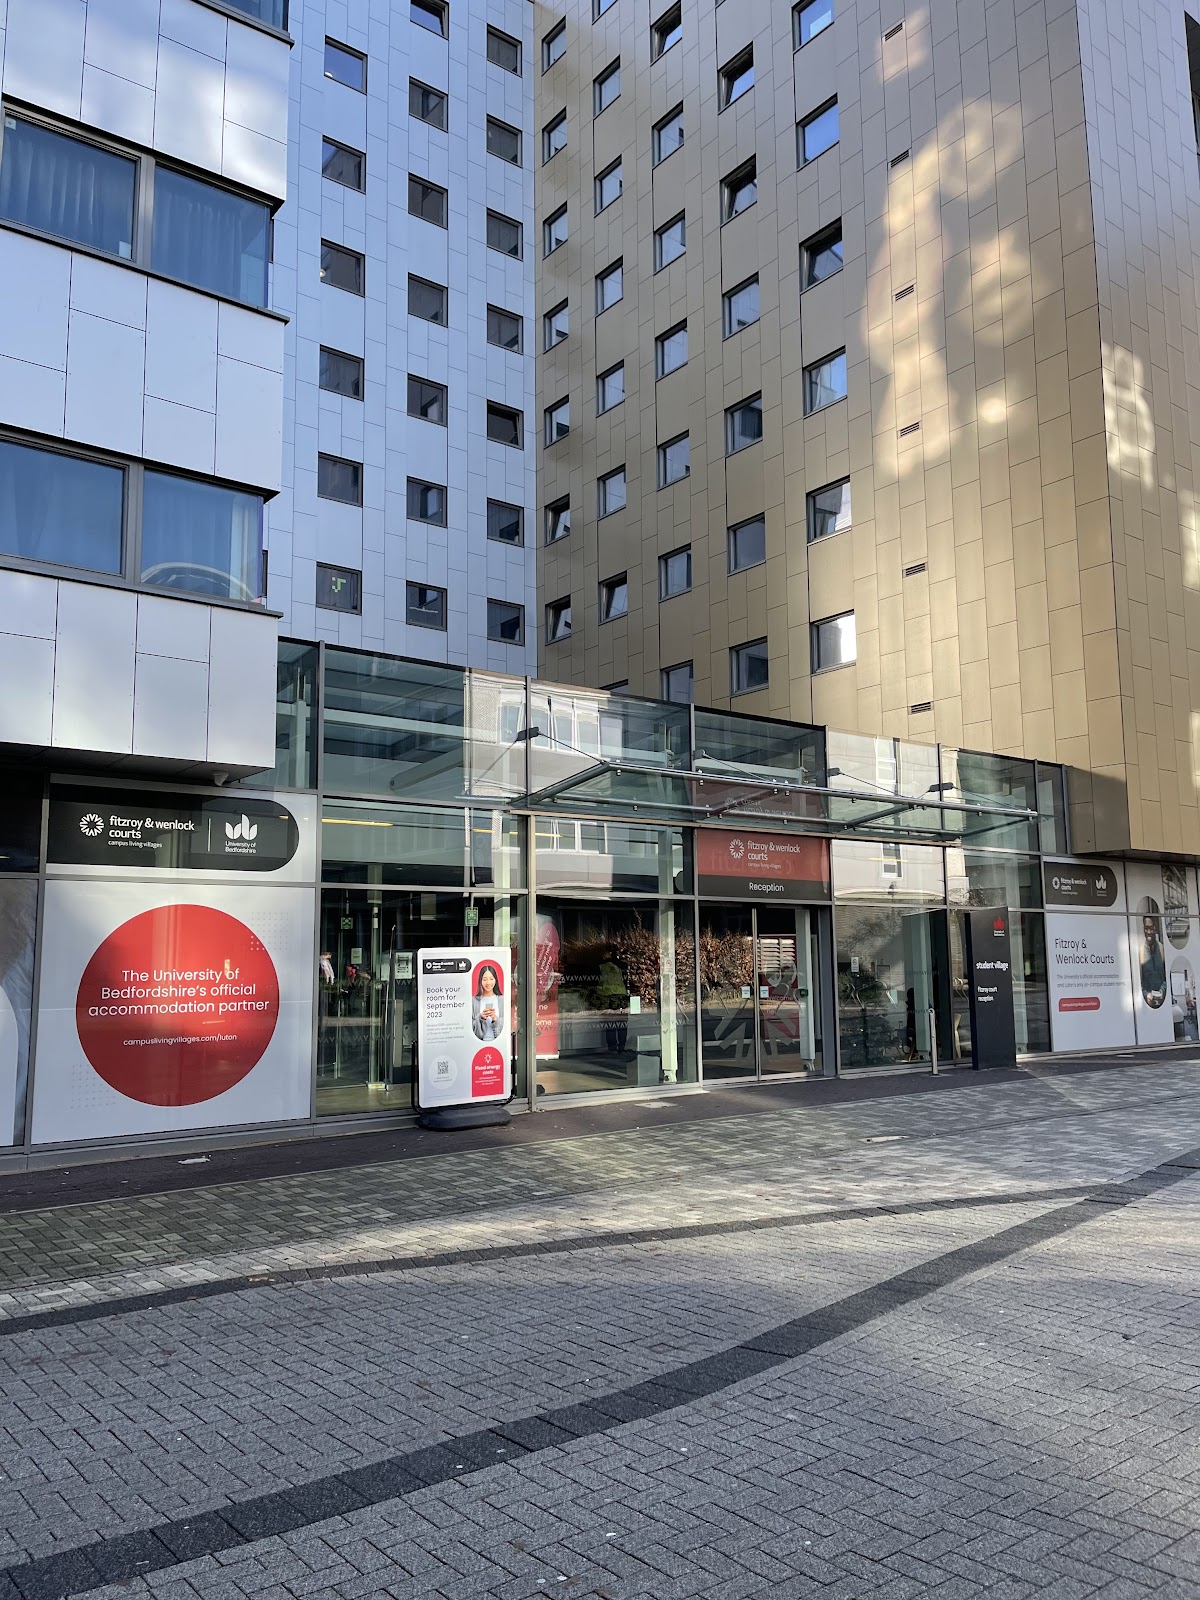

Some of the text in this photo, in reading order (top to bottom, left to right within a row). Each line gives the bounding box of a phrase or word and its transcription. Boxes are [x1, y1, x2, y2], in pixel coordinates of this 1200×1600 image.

[109, 815, 195, 831] fitzroy & wenlock
[108, 829, 142, 839] courts
[129, 840, 143, 849] living
[144, 841, 163, 849] villages
[225, 840, 250, 848] University
[747, 840, 801, 853] fitzroy & wenlock
[747, 852, 768, 861] courts
[749, 882, 785, 893] Reception
[1055, 938, 1087, 952] Fitzroy &
[1055, 953, 1115, 964] Wenlock Courts
[976, 961, 1009, 972] student village
[122, 968, 240, 983] The University of
[101, 984, 256, 1000] Bedfordshire’s official
[426, 986, 461, 995] Book your
[88, 1000, 270, 1016] accommodation partner
[426, 1001, 466, 1011] September
[426, 1011, 443, 1019] 2023
[536, 1017, 554, 1025] ome.
[123, 1033, 237, 1046] campuslivingvillages.com/luton
